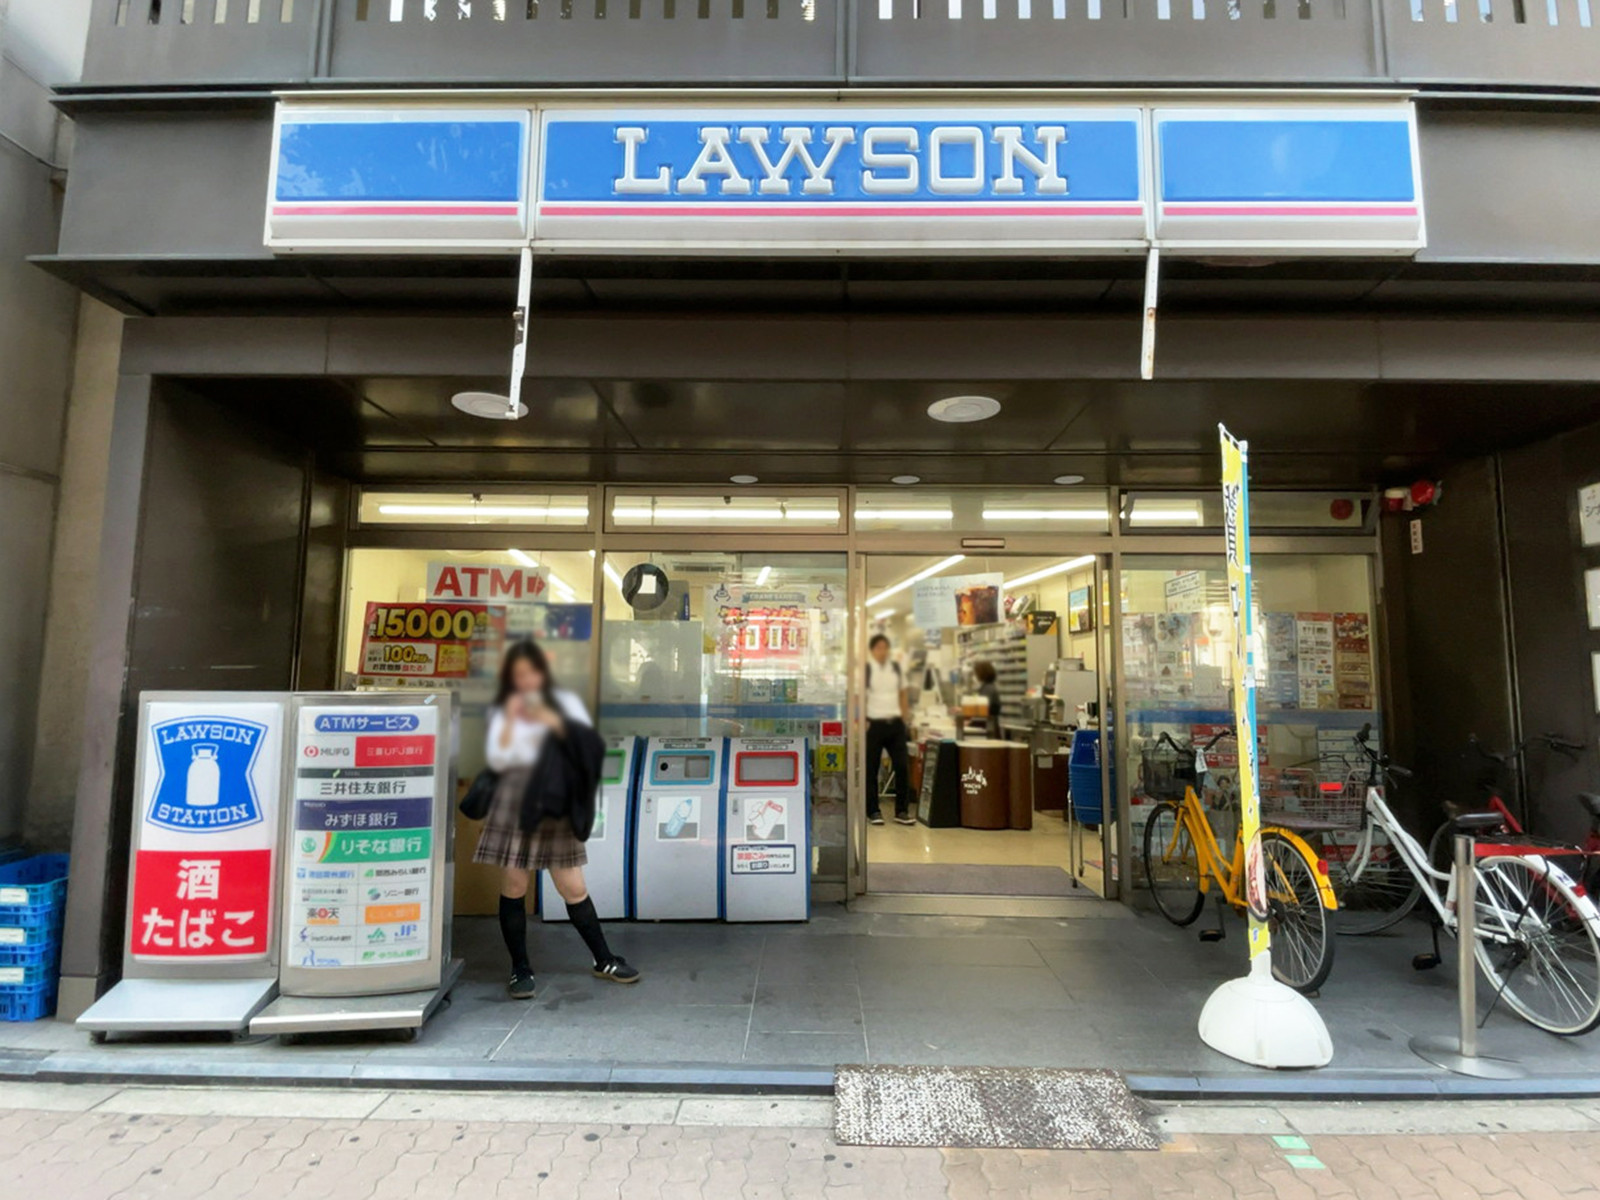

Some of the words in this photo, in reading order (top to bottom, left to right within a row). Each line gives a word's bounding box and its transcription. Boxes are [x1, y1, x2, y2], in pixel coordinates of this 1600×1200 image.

[613, 126, 1068, 195] LAWSON
[433, 566, 523, 599] ATM
[320, 716, 413, 730] ATMサービス
[160, 724, 255, 746] LAWSON
[320, 747, 350, 756] MUFG
[320, 780, 407, 795] 三井住友銀行
[156, 803, 250, 826] STATION
[324, 812, 399, 827] みずほ銀行
[341, 837, 423, 855] りそな銀行
[175, 859, 222, 901] 酒
[141, 907, 256, 949] たばこ
